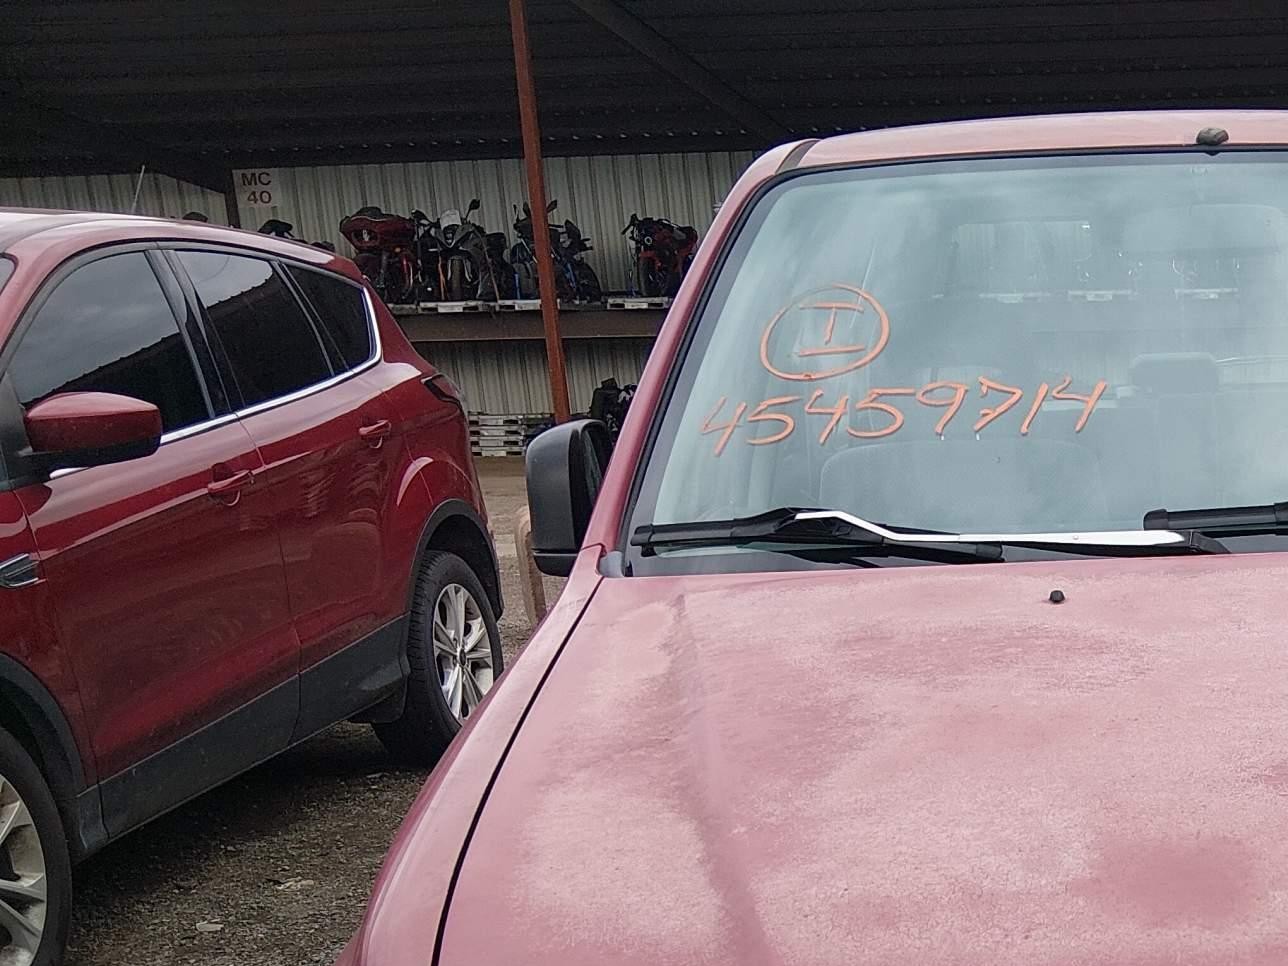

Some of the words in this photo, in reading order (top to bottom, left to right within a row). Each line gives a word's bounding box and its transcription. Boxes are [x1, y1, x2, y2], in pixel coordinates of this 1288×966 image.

[241, 172, 272, 186] MC
[247, 190, 272, 204] 40
[701, 373, 1108, 457] 45459714
